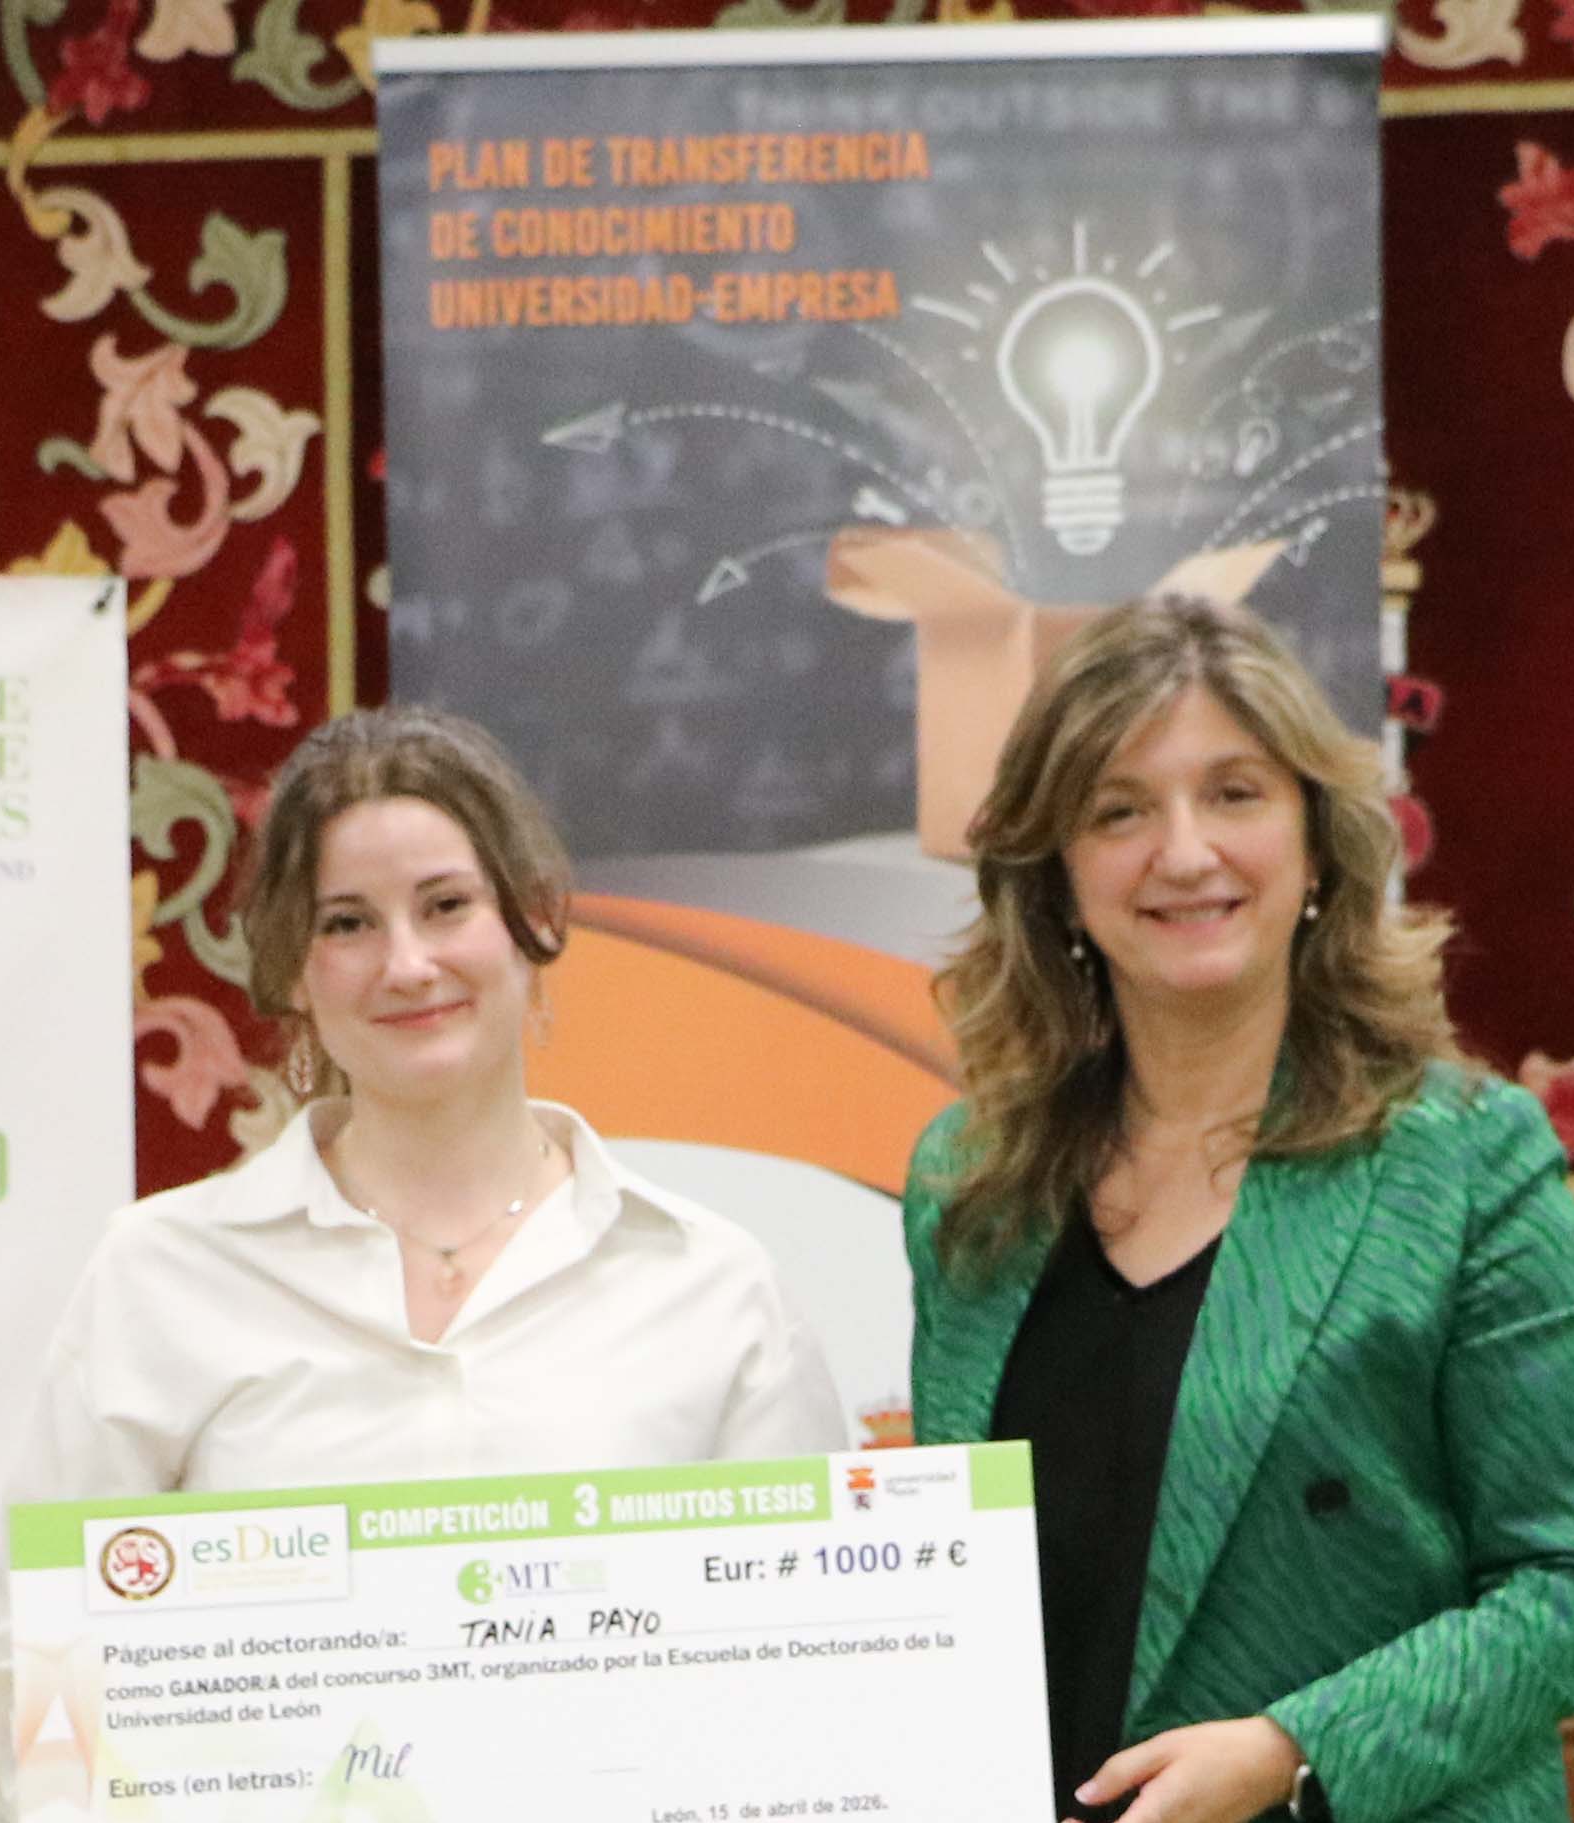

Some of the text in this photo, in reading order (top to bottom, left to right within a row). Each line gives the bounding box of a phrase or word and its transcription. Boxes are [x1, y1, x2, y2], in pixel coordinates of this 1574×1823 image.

[428, 130, 930, 191] PLAN DE TRANSFERENCIA
[430, 202, 795, 260] DE CONOCIMIENTO
[430, 269, 901, 329] UNIVERSIDAD-EMPRESA
[359, 1482, 816, 1541] COMPETICIÓN 3 MINUTOS TESIS
[192, 1525, 330, 1564] esDule
[705, 1540, 967, 1583] Eur: # 1000 # €
[589, 1607, 661, 1637] PAYO
[104, 1629, 407, 1667] Páguese al doctorando/a:
[106, 1685, 164, 1702] como
[286, 1671, 318, 1689] del
[323, 1667, 421, 1688] concurso
[426, 1663, 474, 1683] 3MT,
[481, 1653, 598, 1681] organizado
[604, 1653, 637, 1674] por
[643, 1648, 662, 1666] la
[668, 1643, 751, 1666] Escuela
[757, 1642, 782, 1660] de
[788, 1637, 900, 1659] Doctorado
[905, 1635, 931, 1653] de
[937, 1632, 955, 1649] la
[107, 1698, 321, 1730] Universidad de León
[109, 1768, 312, 1798] Euros (en letras):
[342, 1742, 413, 1784] Mil
[709, 1804, 729, 1821] 15
[740, 1801, 761, 1819] de
[767, 1799, 807, 1817] abril
[813, 1797, 834, 1815] de
